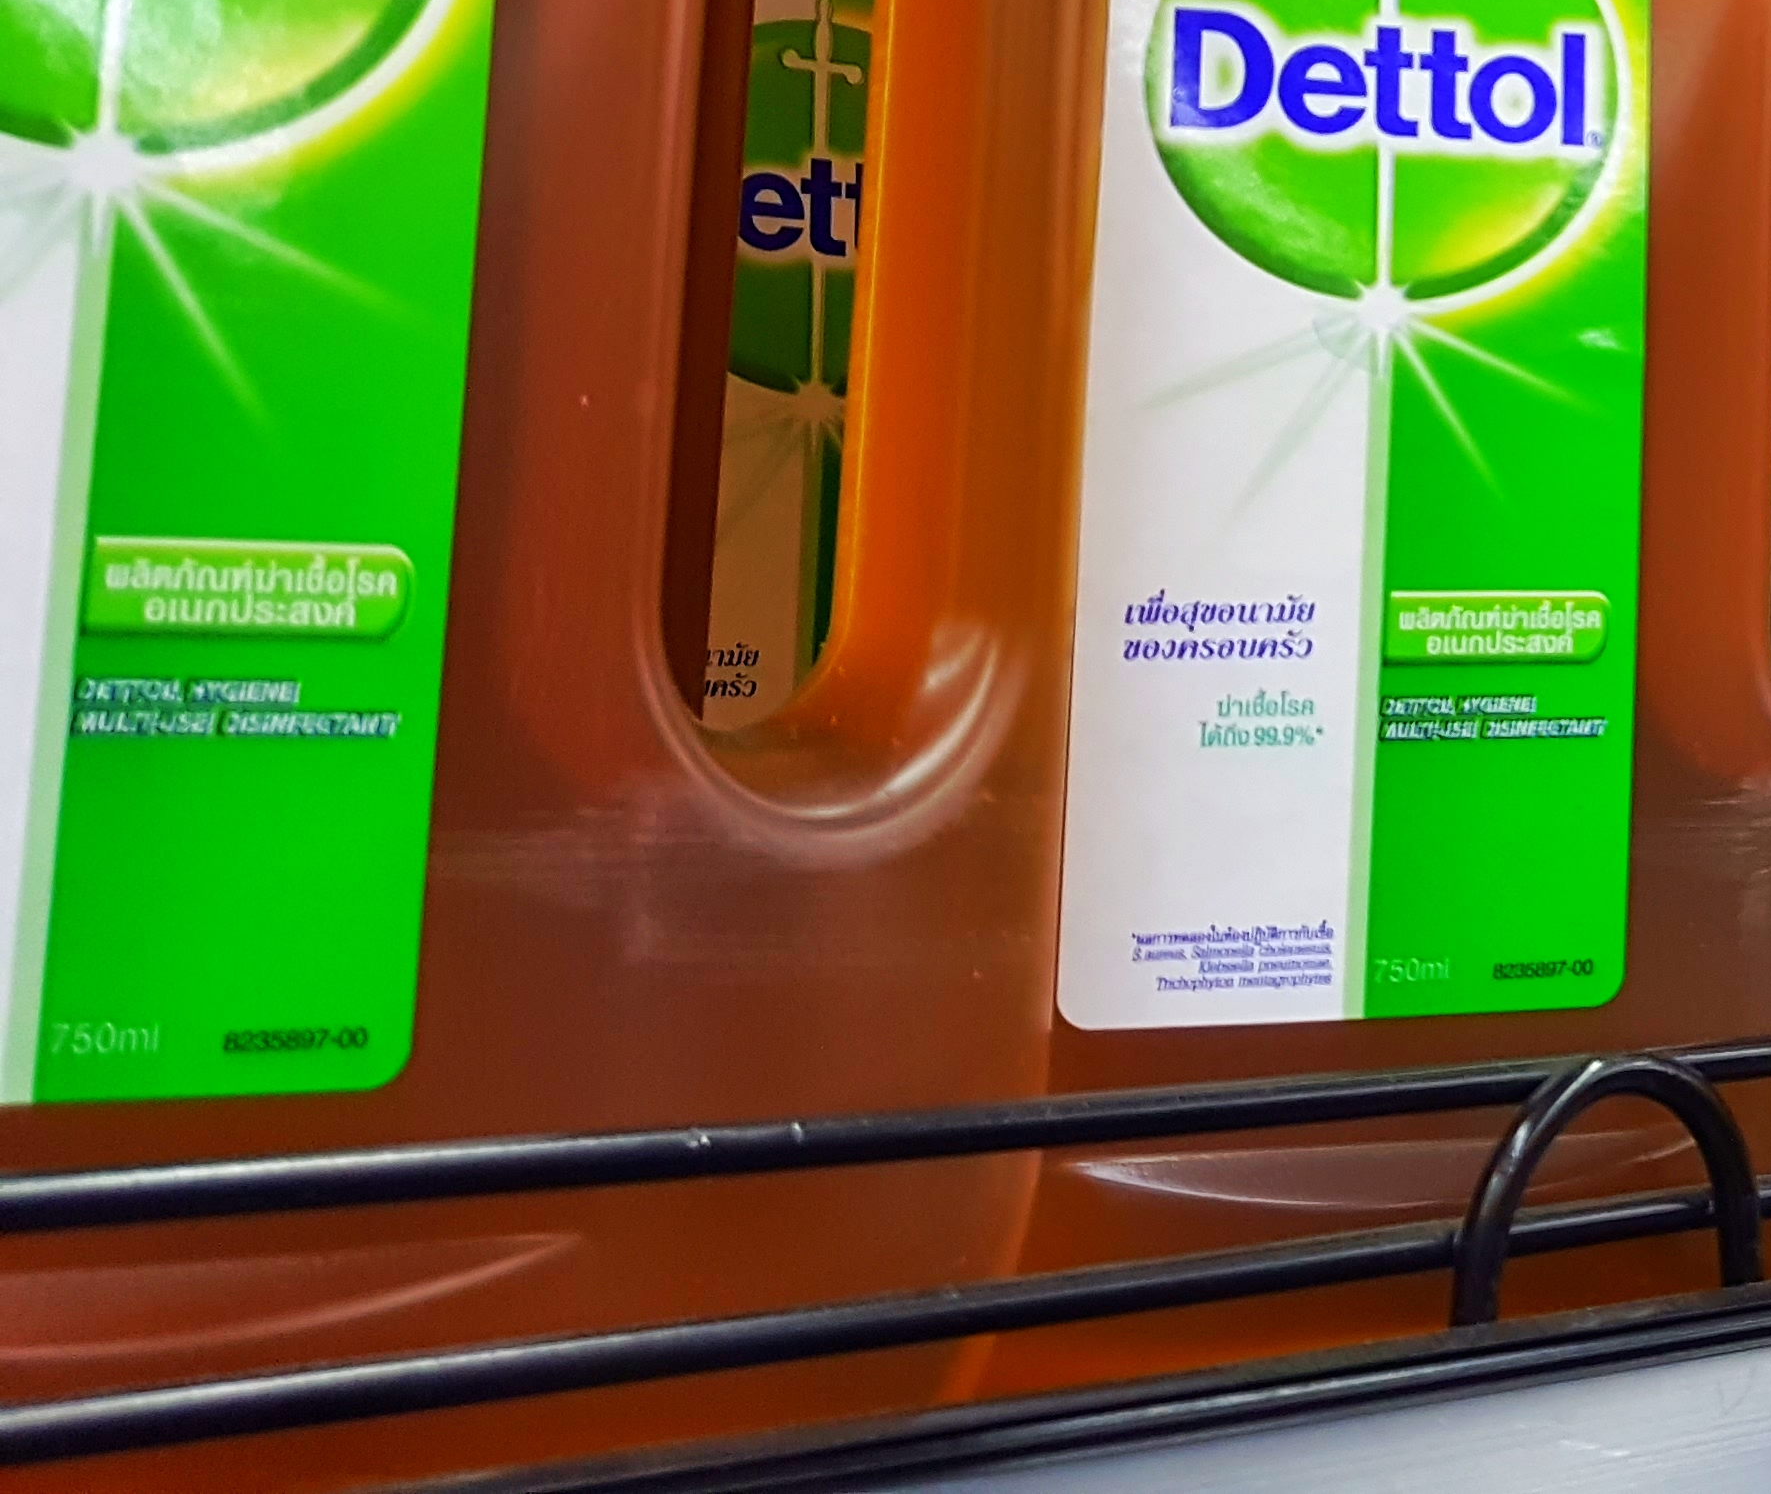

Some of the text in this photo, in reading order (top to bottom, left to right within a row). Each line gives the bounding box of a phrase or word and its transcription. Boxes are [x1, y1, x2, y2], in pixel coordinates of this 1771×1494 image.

[1169, 6, 1591, 146] Dettol
[1124, 588, 1317, 633] เพื่อสุขอนามัย
[1123, 628, 1314, 660] ของครอบครัว
[1374, 957, 1449, 983] 750ml
[50, 1022, 160, 1055] 750ml
